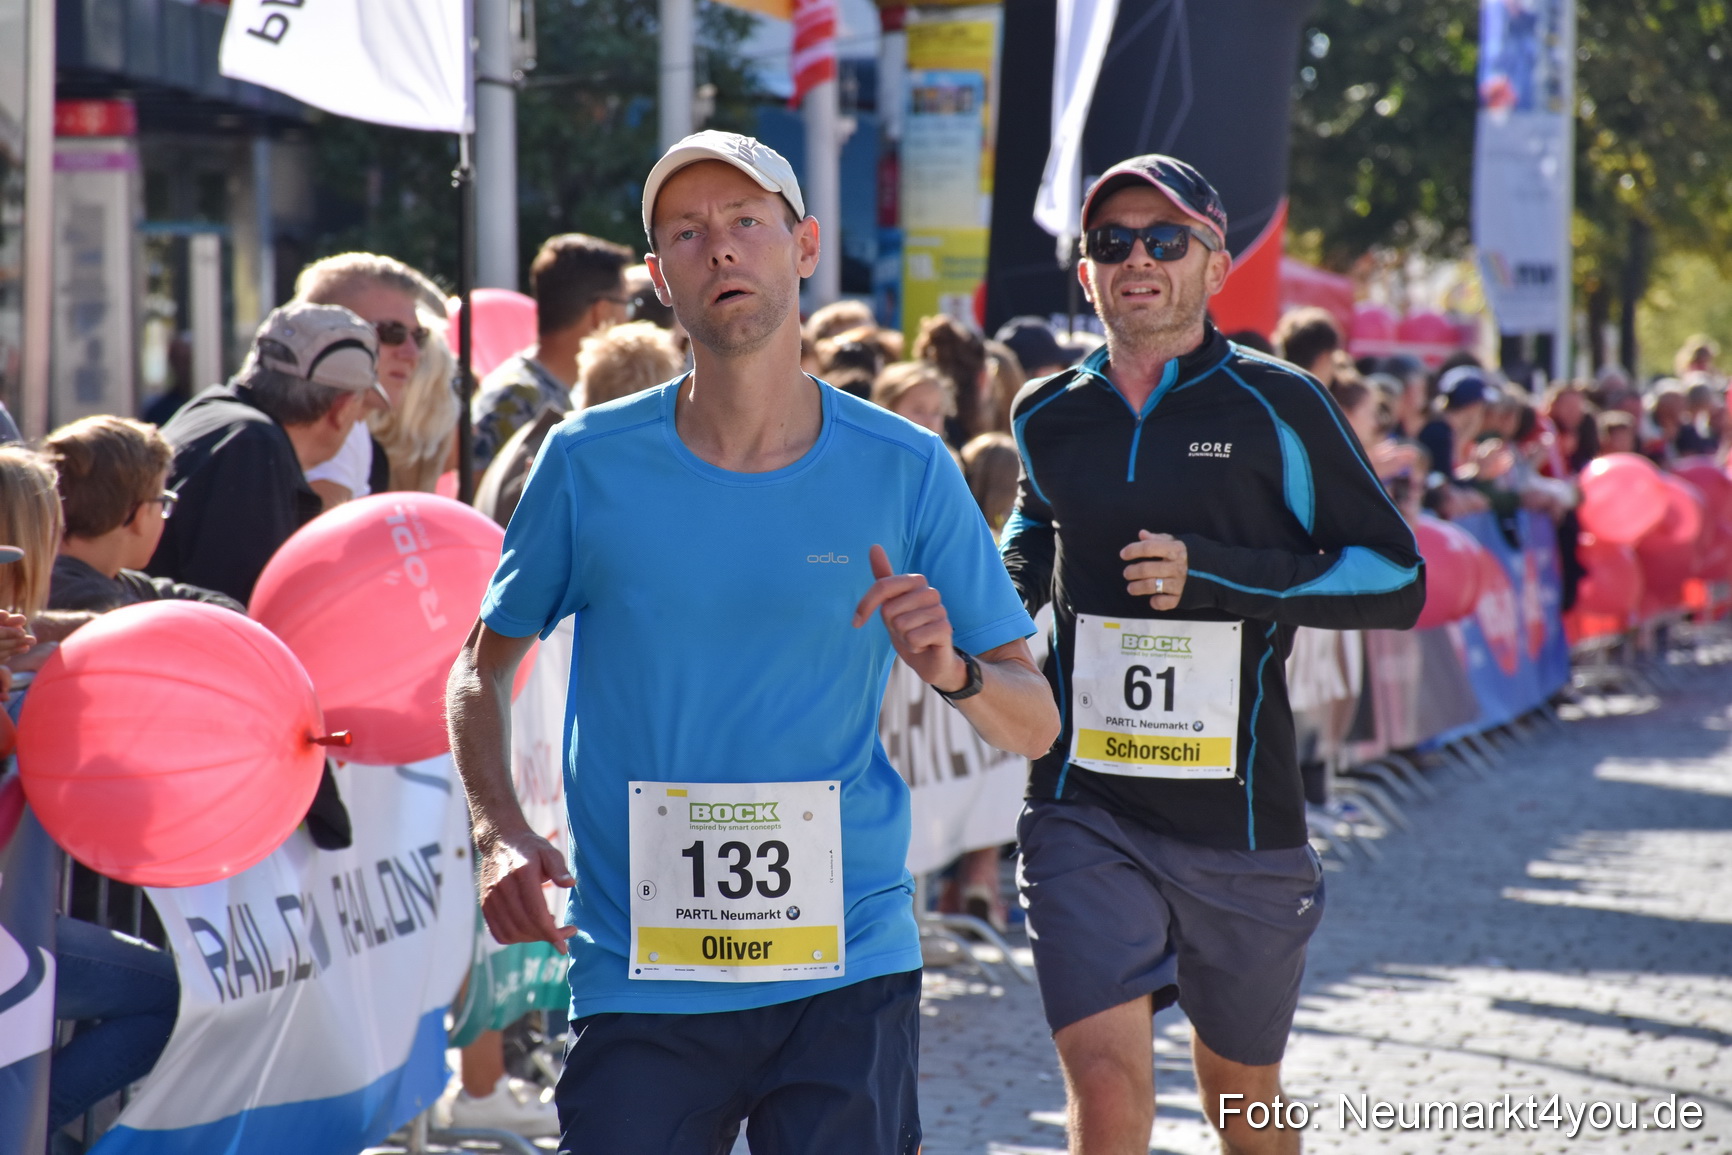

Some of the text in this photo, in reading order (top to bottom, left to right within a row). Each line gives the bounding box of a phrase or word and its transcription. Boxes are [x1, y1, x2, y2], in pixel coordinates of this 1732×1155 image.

[1189, 442, 1232, 453] GORE
[806, 552, 849, 564] odlo
[1122, 633, 1191, 653] BOCK
[1124, 664, 1175, 712] 61
[1105, 716, 1188, 731] PARTL Neumarkt
[1105, 737, 1201, 762] Schorschi
[690, 802, 780, 823] BOCK
[689, 823, 716, 831] inspired
[718, 823, 727, 831] by
[750, 823, 781, 831] concepts
[681, 840, 792, 899] 133
[643, 886, 650, 896] B
[675, 908, 781, 921] PARTL Neumarkt
[702, 935, 773, 960] Oliver
